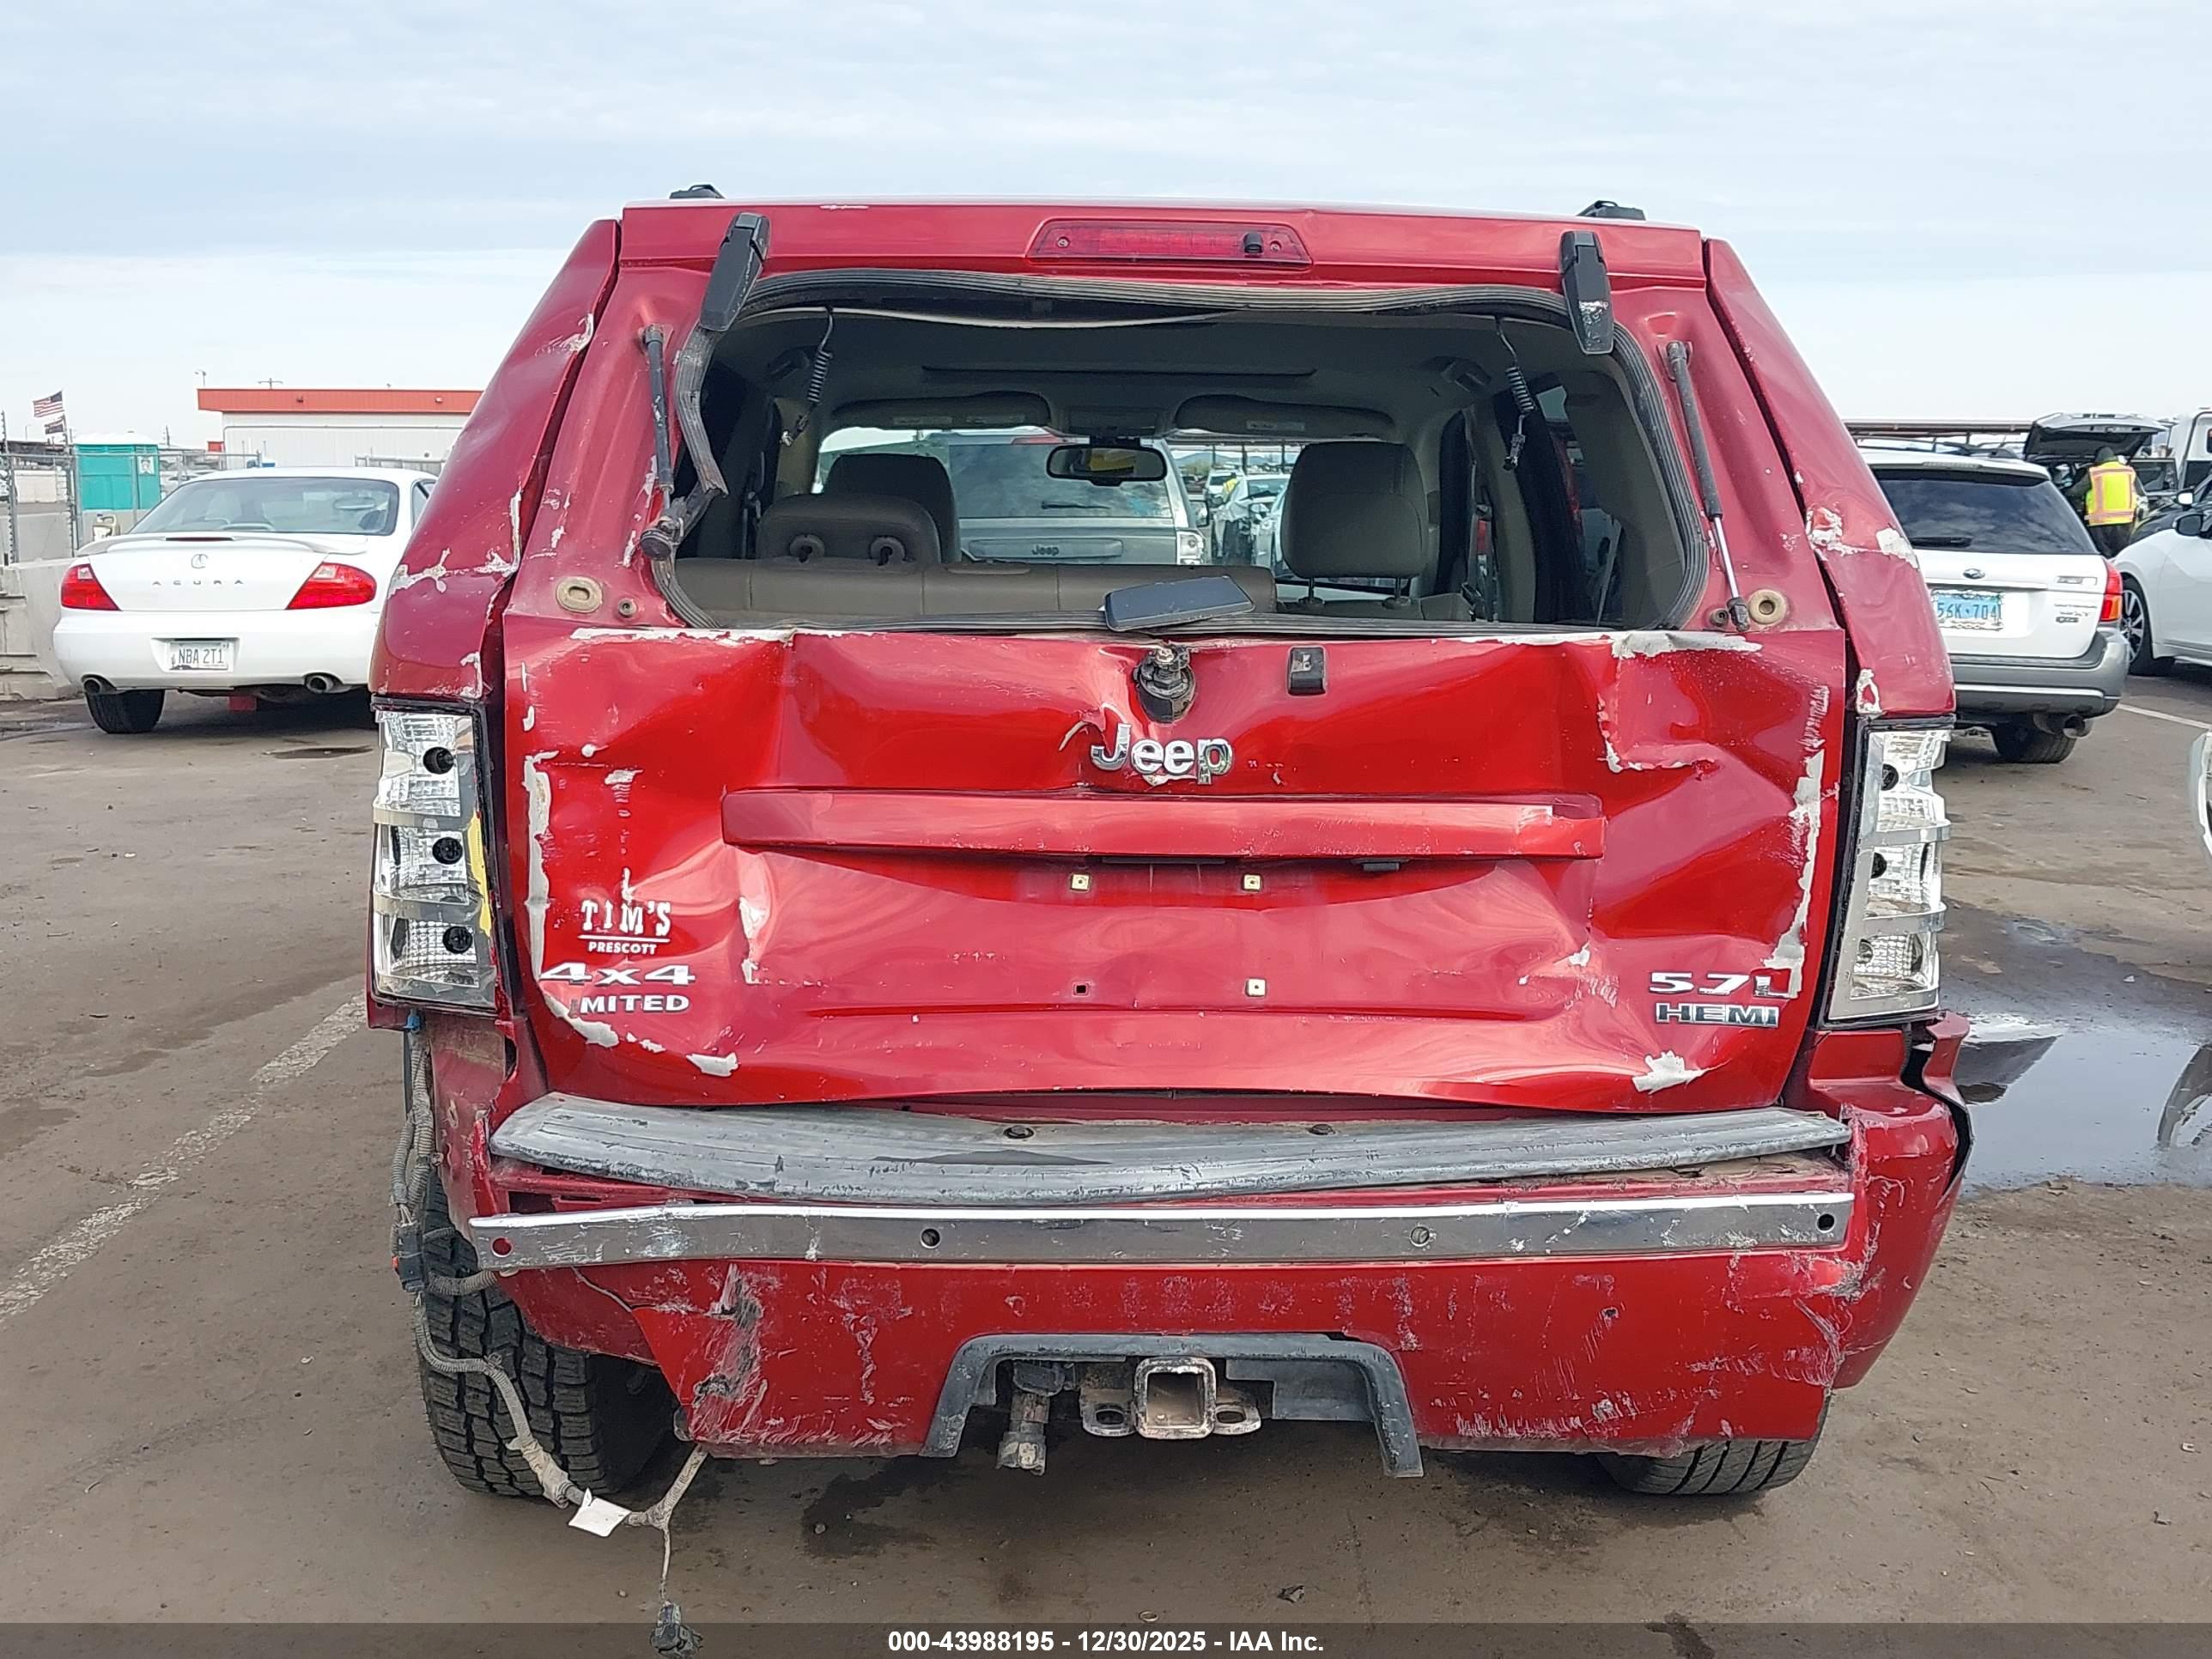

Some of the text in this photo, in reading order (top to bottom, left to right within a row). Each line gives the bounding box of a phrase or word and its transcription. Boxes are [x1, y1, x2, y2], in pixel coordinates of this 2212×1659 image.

[1031, 544, 1060, 556] Jeep
[179, 648, 224, 664] NBA 2T1
[1091, 722, 1233, 785] Jeep
[580, 899, 672, 937] TIM'S
[588, 941, 657, 955] PRESCOTT
[539, 962, 696, 987] 4x4
[1655, 1002, 1780, 1028] HEMI
